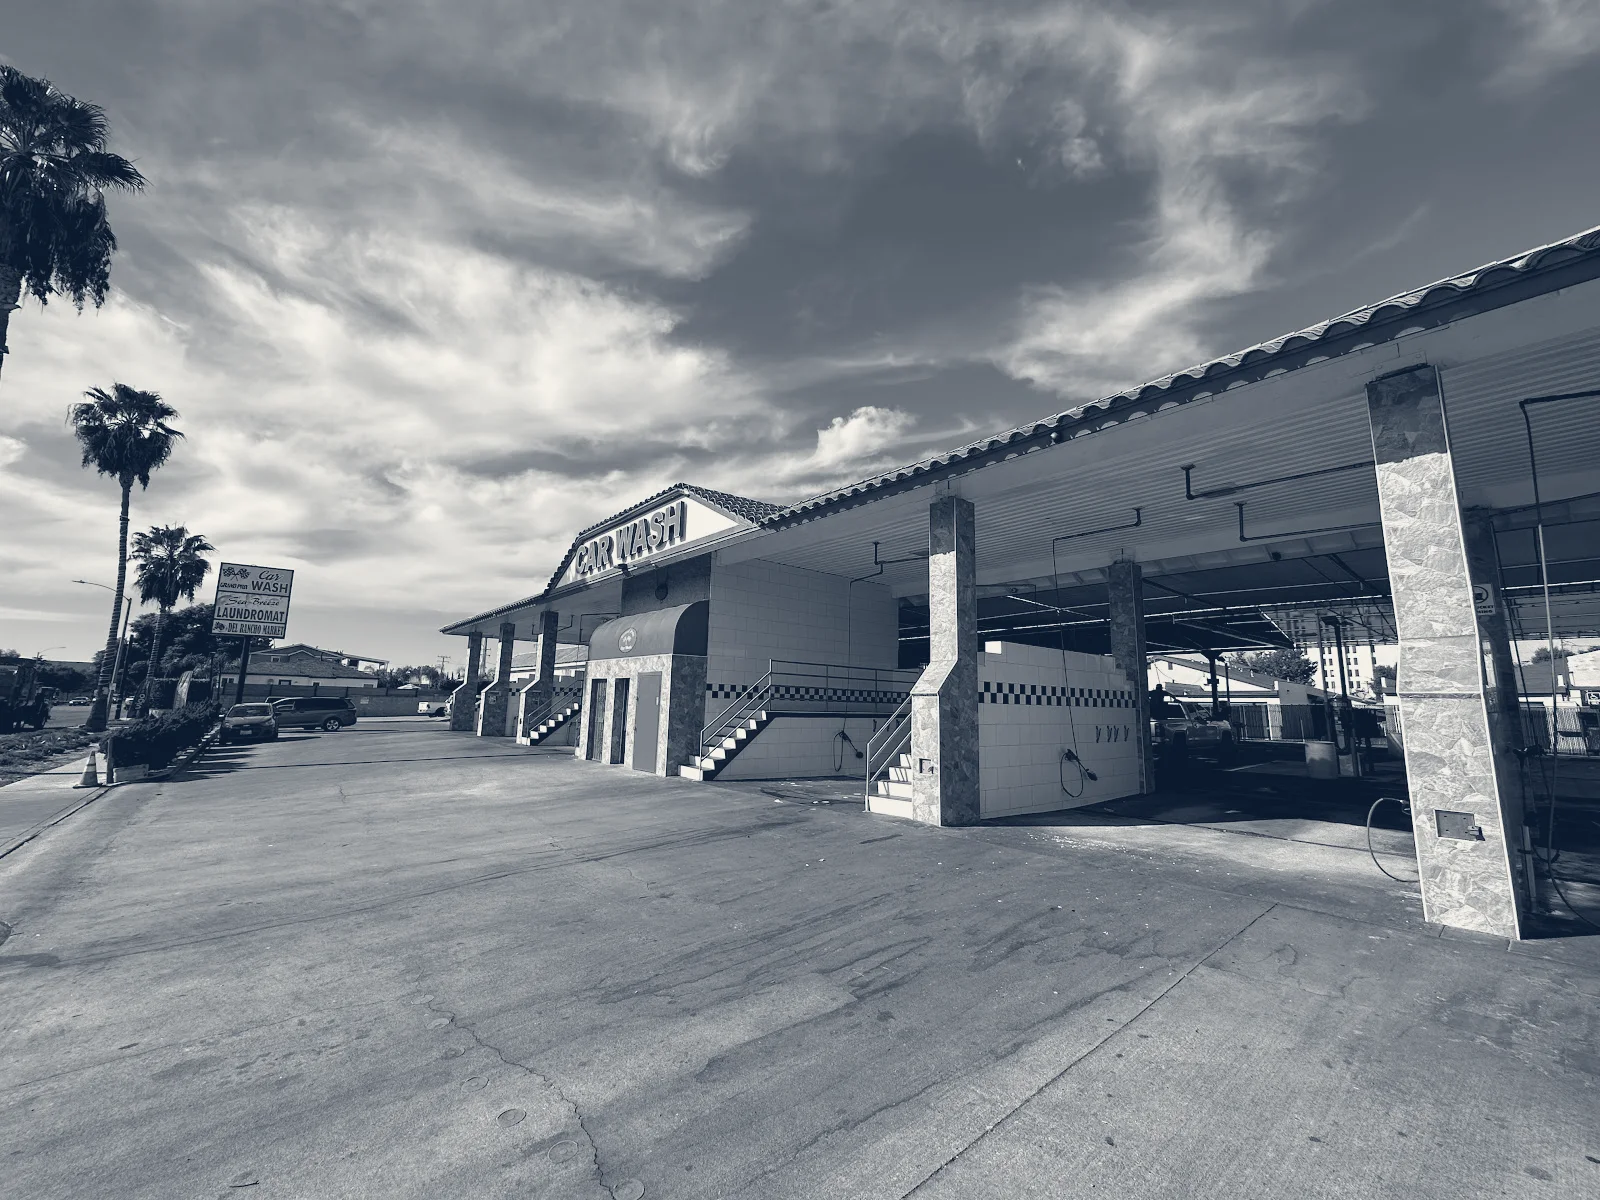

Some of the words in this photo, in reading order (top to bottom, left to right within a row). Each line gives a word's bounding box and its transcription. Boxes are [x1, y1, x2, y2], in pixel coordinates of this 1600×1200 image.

[575, 536, 612, 575] CAR
[616, 501, 684, 561] WASH
[259, 570, 283, 582] Car
[252, 580, 288, 593] WASH
[217, 607, 285, 622] LAUNDROMAT
[228, 623, 238, 632] DEL
[240, 624, 261, 634] RANCHO
[262, 625, 284, 635] MARKET
